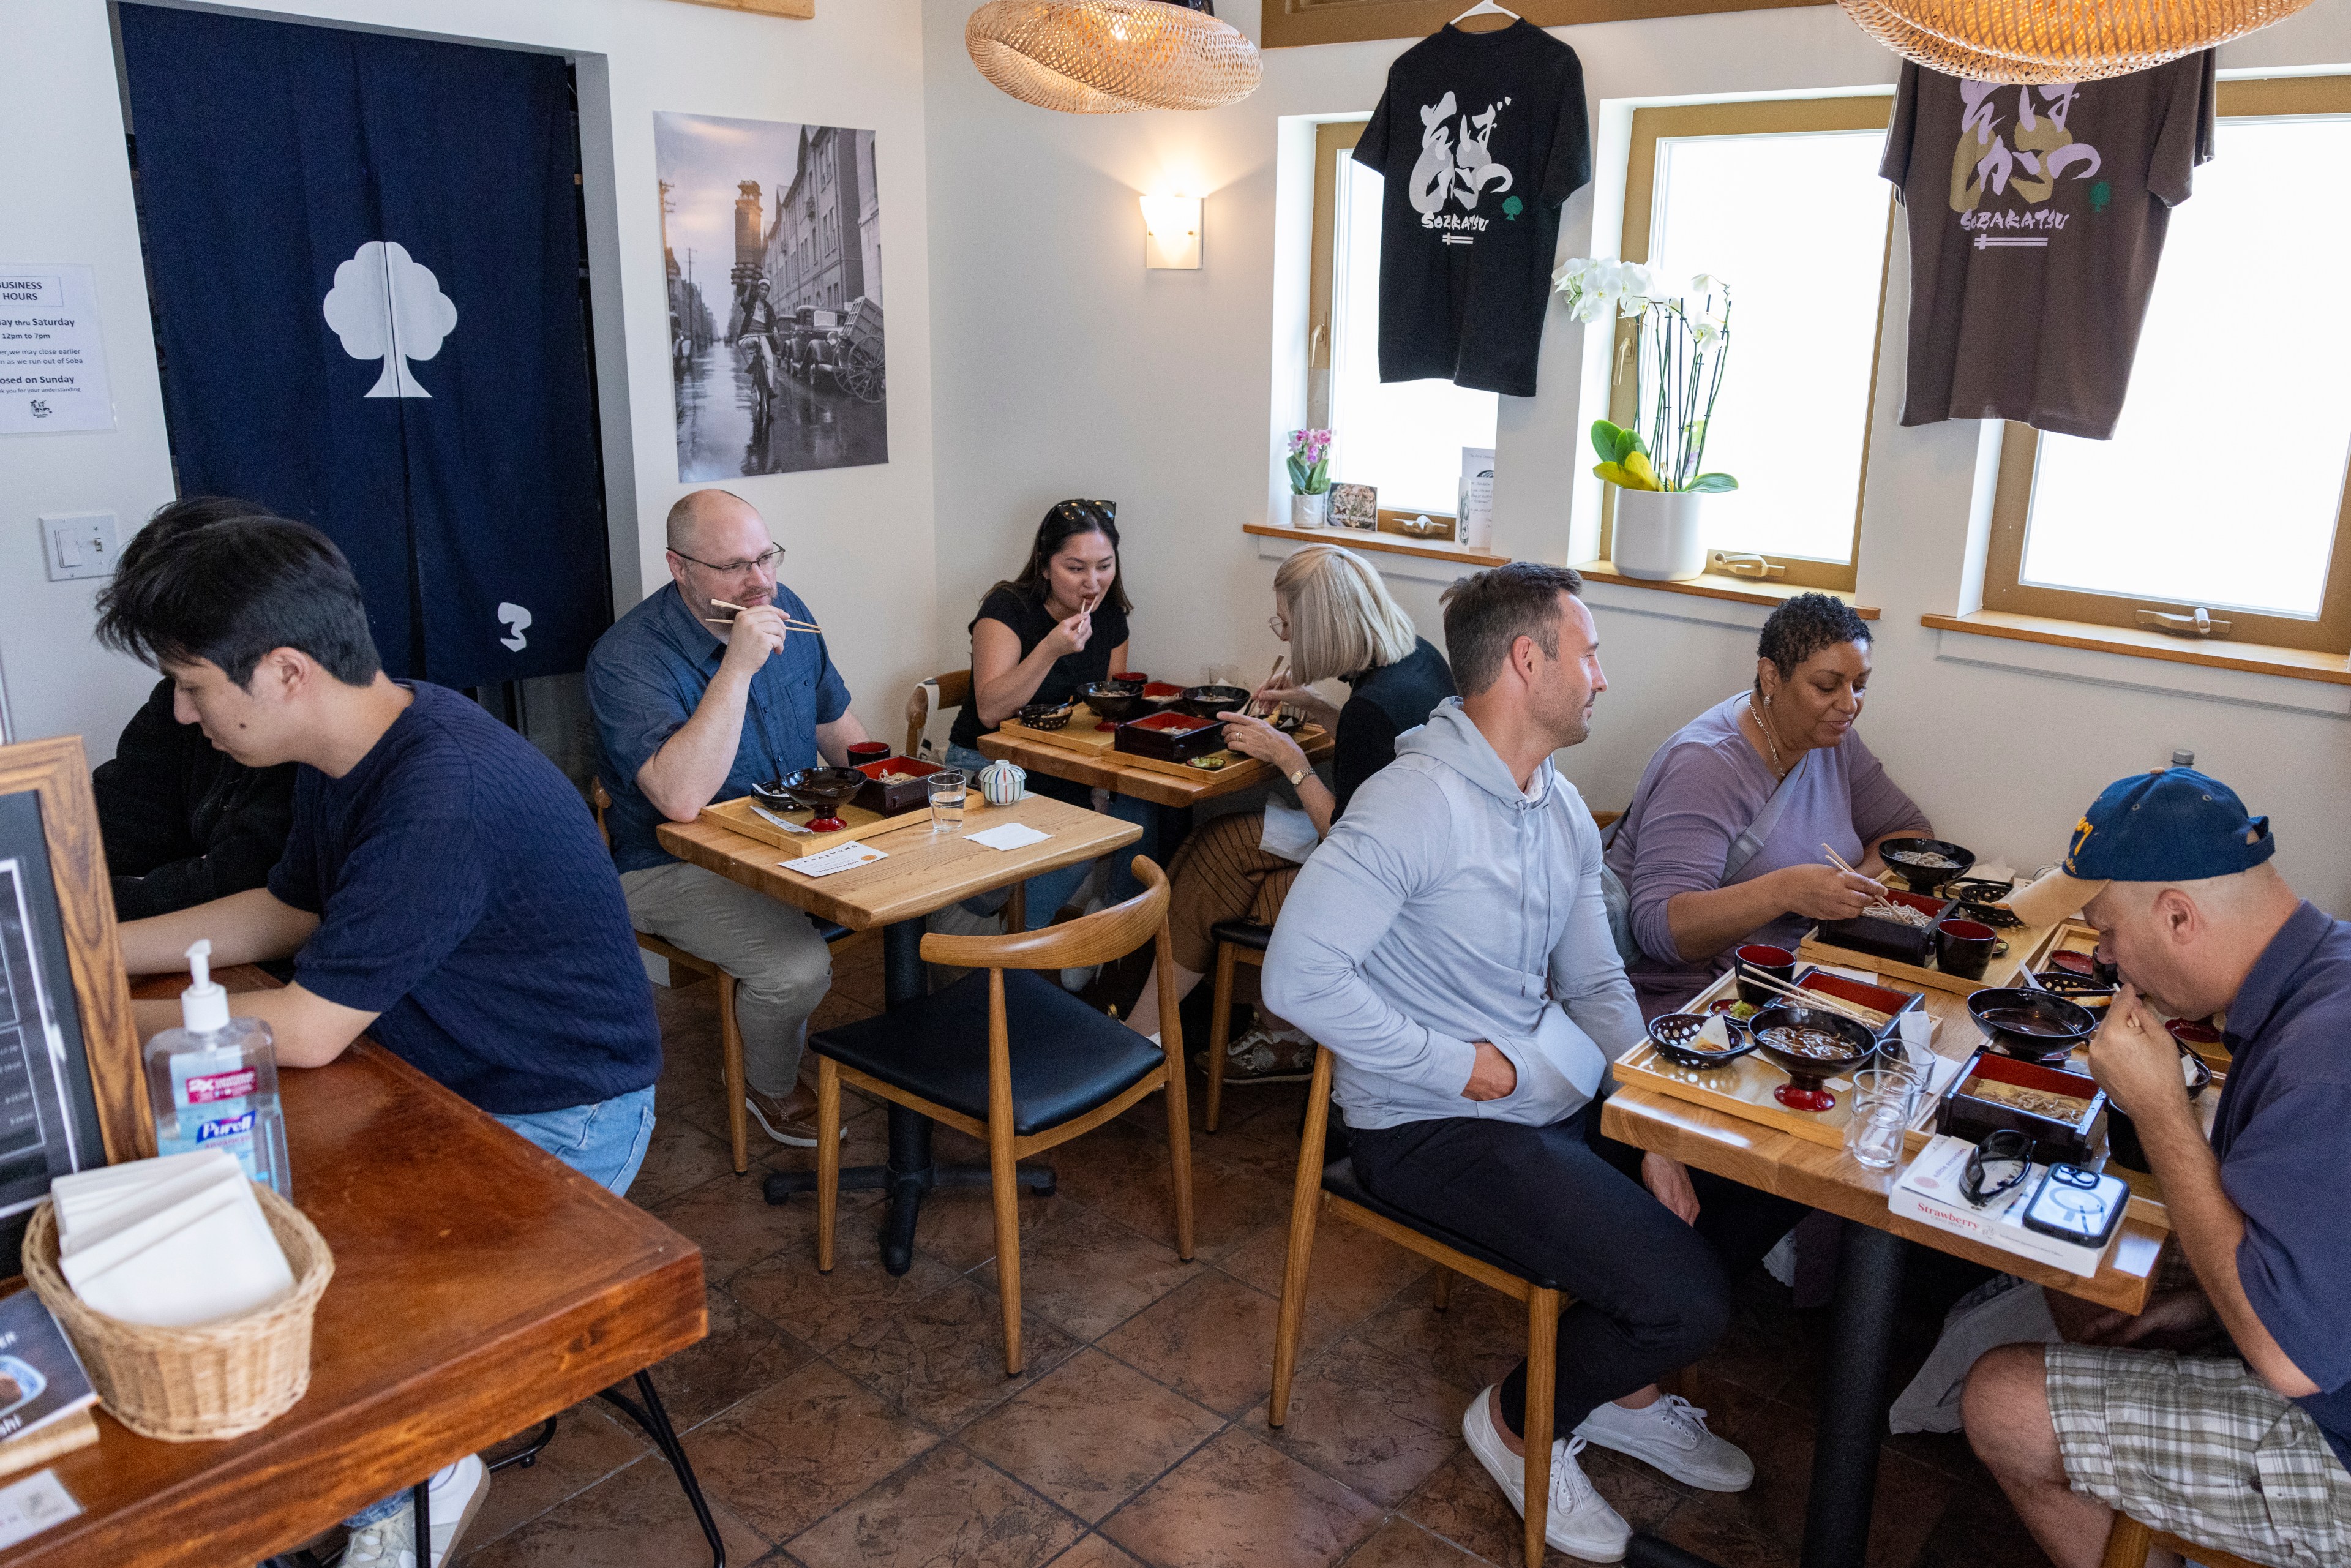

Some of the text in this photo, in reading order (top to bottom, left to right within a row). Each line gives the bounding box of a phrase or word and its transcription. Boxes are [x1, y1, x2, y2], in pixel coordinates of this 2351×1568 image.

[1960, 208, 2070, 231] SOBAKATSU
[32, 318, 75, 327] Saturday
[40, 375, 75, 384] Sunday
[1918, 1202, 1979, 1230] Strawberry
